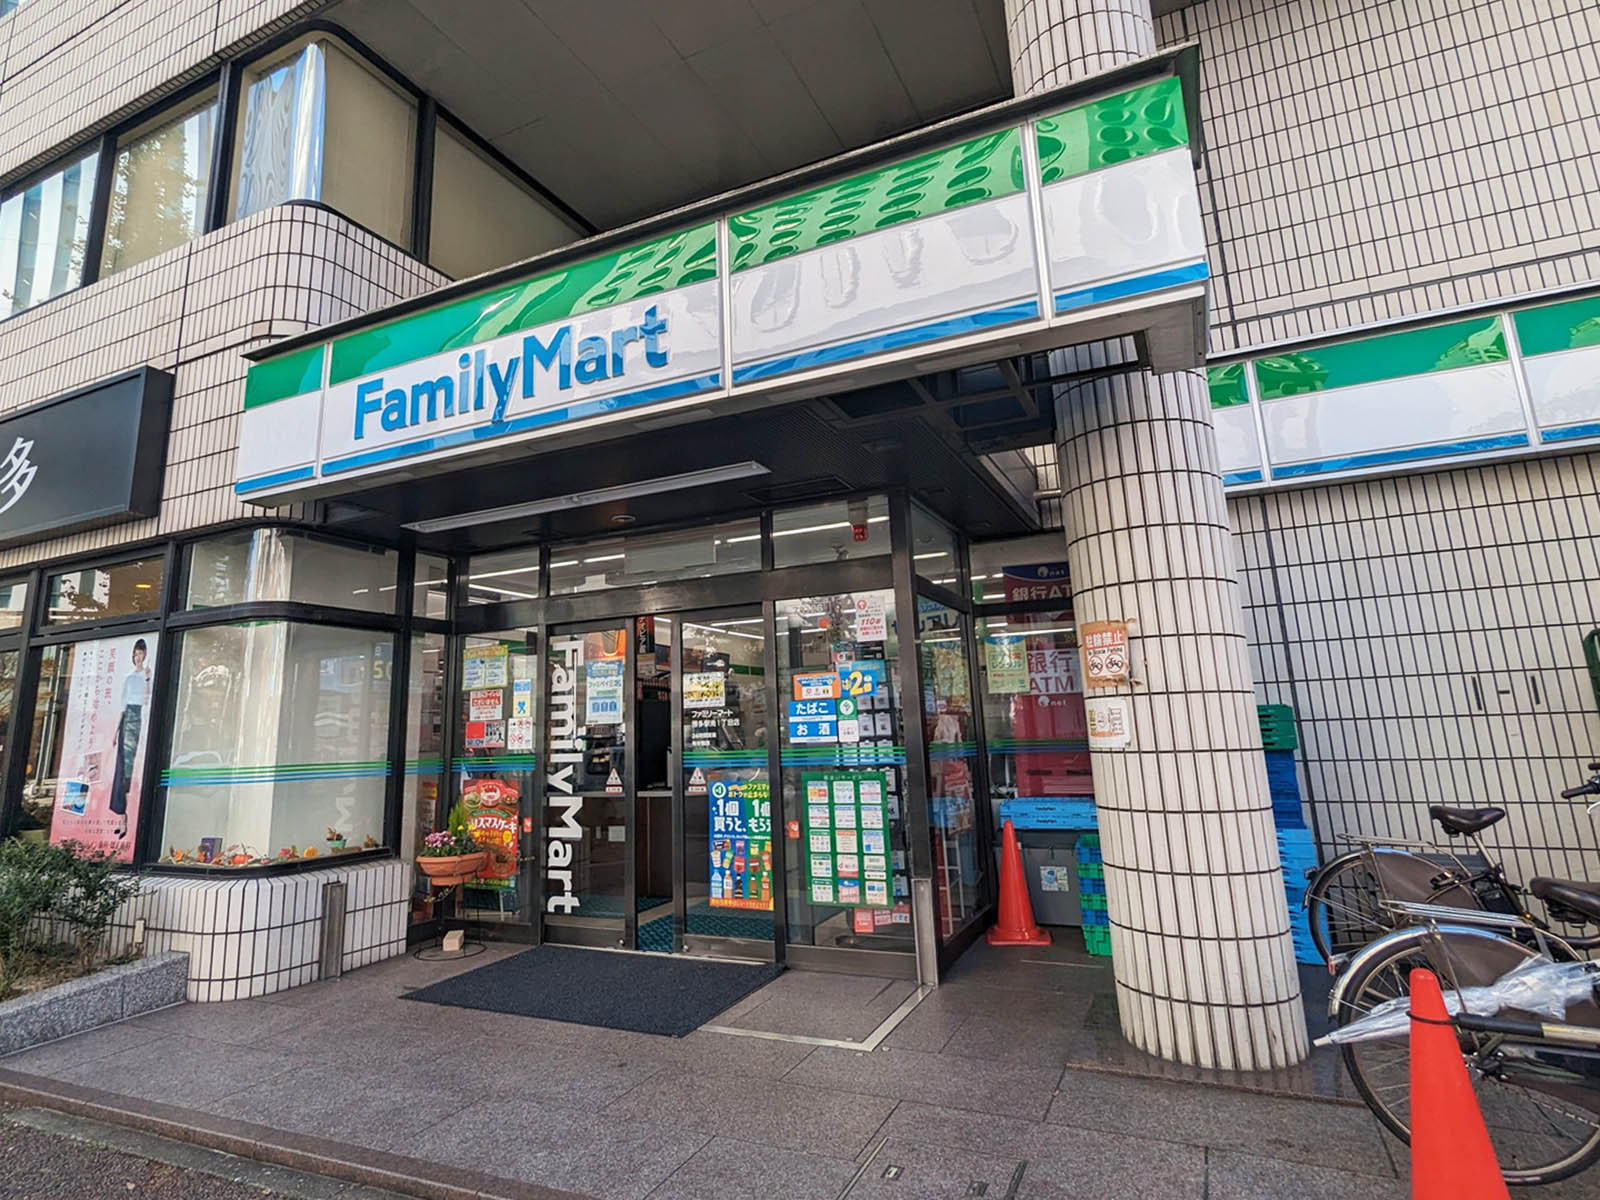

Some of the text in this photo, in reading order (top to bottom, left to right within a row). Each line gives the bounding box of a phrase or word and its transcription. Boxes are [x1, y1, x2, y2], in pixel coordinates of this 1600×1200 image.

[354, 304, 668, 440] FamilyMart
[0, 436, 39, 514] 多
[1027, 651, 1072, 673] 銀行
[1030, 676, 1074, 693] ATM
[691, 708, 734, 718] ファミリーマート
[796, 702, 829, 715] たばこ
[547, 640, 584, 914] FamilyMart
[716, 799, 739, 816] 1個
[468, 816, 518, 833] リスマスケーキ
